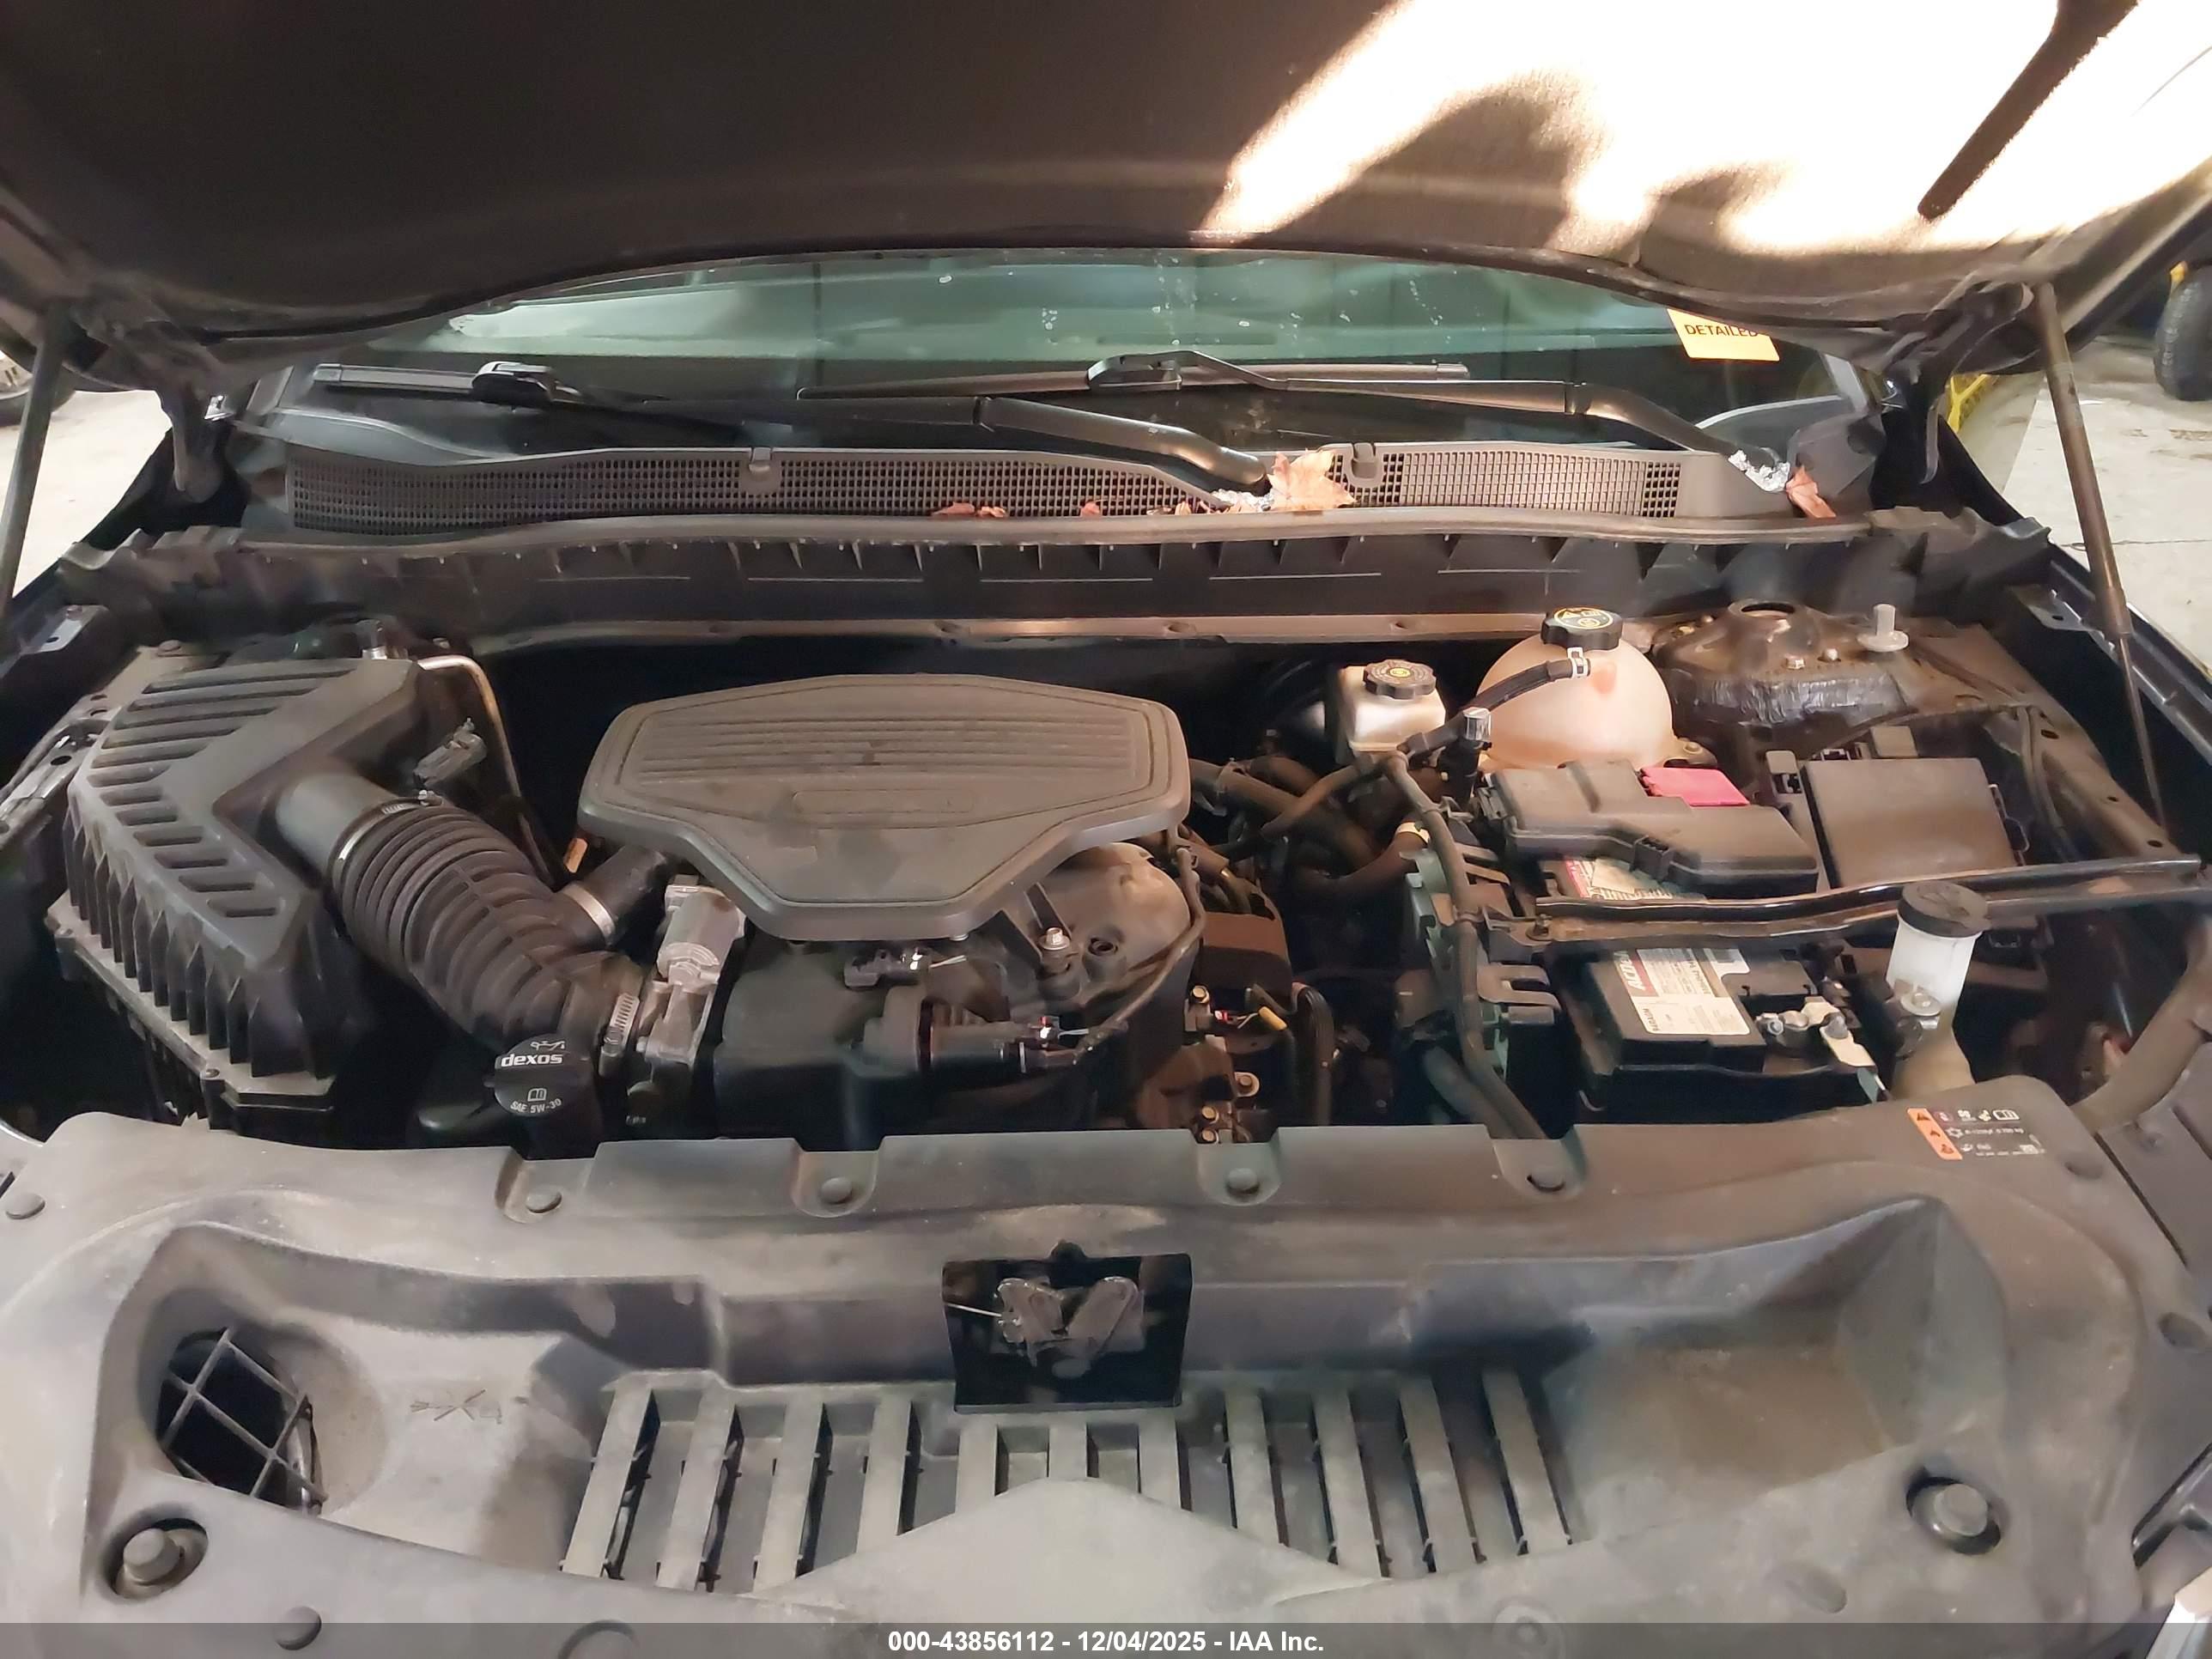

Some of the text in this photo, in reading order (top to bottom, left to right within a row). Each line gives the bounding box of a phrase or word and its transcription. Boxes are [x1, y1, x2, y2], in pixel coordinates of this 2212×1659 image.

[501, 1054, 562, 1066] dexos
[510, 1099, 562, 1113] SAE 5W-30
